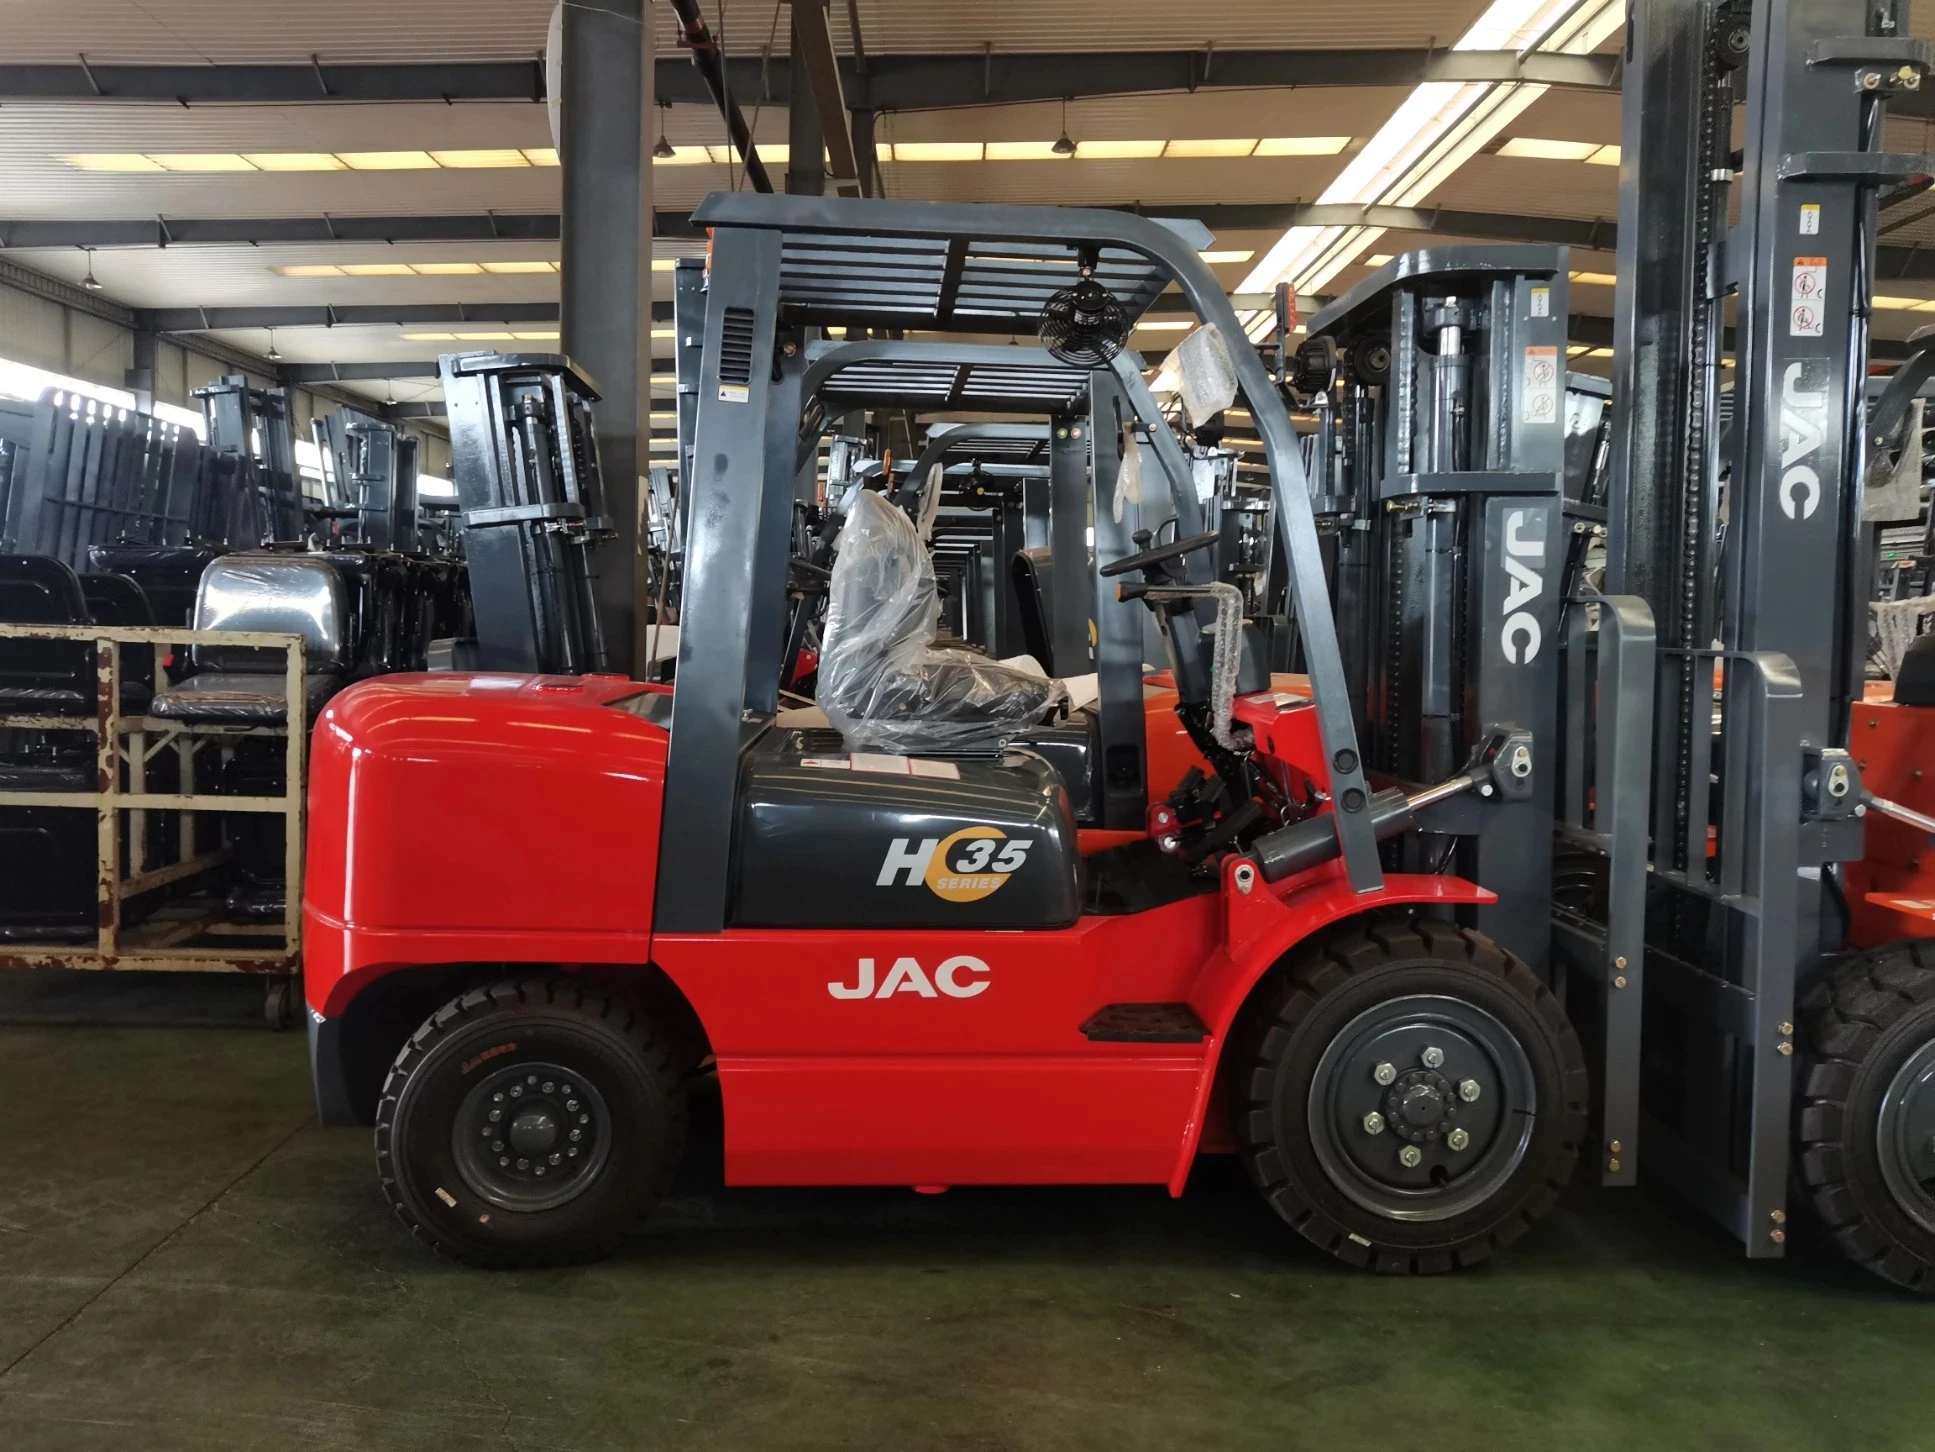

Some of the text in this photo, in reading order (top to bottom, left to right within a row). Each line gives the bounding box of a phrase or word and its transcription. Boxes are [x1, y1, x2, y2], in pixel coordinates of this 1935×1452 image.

[1779, 362, 1823, 520] JAC
[1501, 510, 1545, 665] JAC
[937, 877, 1001, 889] SERIES
[828, 955, 991, 999] JAC
